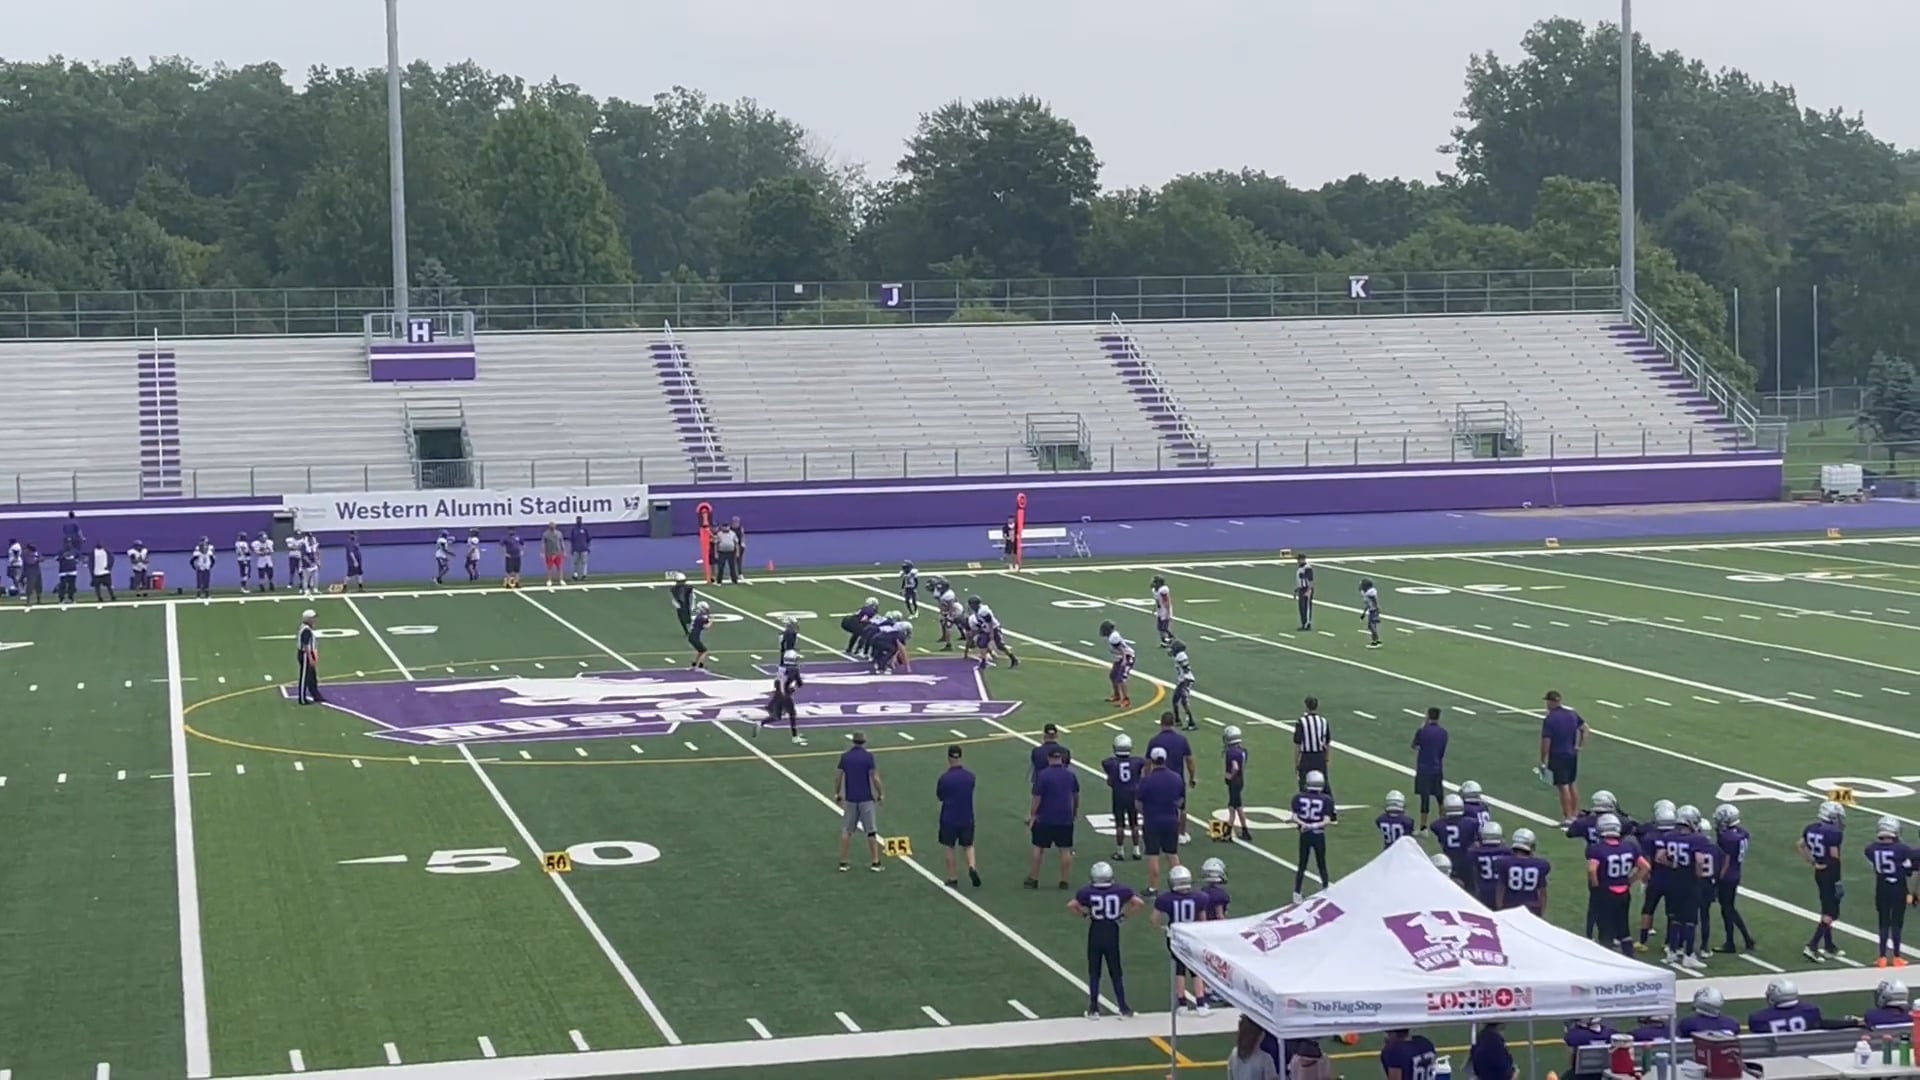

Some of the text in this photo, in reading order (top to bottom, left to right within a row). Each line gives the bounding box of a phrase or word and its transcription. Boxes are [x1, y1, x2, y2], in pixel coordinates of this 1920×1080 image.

[887, 287, 899, 306] J
[1351, 279, 1367, 298] K
[412, 322, 429, 342] H
[336, 500, 427, 520] Western
[434, 498, 513, 518] Alumni
[519, 495, 613, 516] Stadium
[409, 702, 981, 740] MUSTANGS
[1119, 761, 1132, 783] 6
[1299, 797, 1324, 821] 32
[1445, 825, 1461, 848] 2
[1606, 852, 1633, 878] 66
[1873, 850, 1897, 875] 15
[1507, 865, 1540, 892] 89
[1090, 894, 1121, 921] 20
[1172, 899, 1196, 923] 10
[1594, 981, 1663, 996] The Flag Shop
[1312, 1000, 1383, 1014] The Flag Shop
